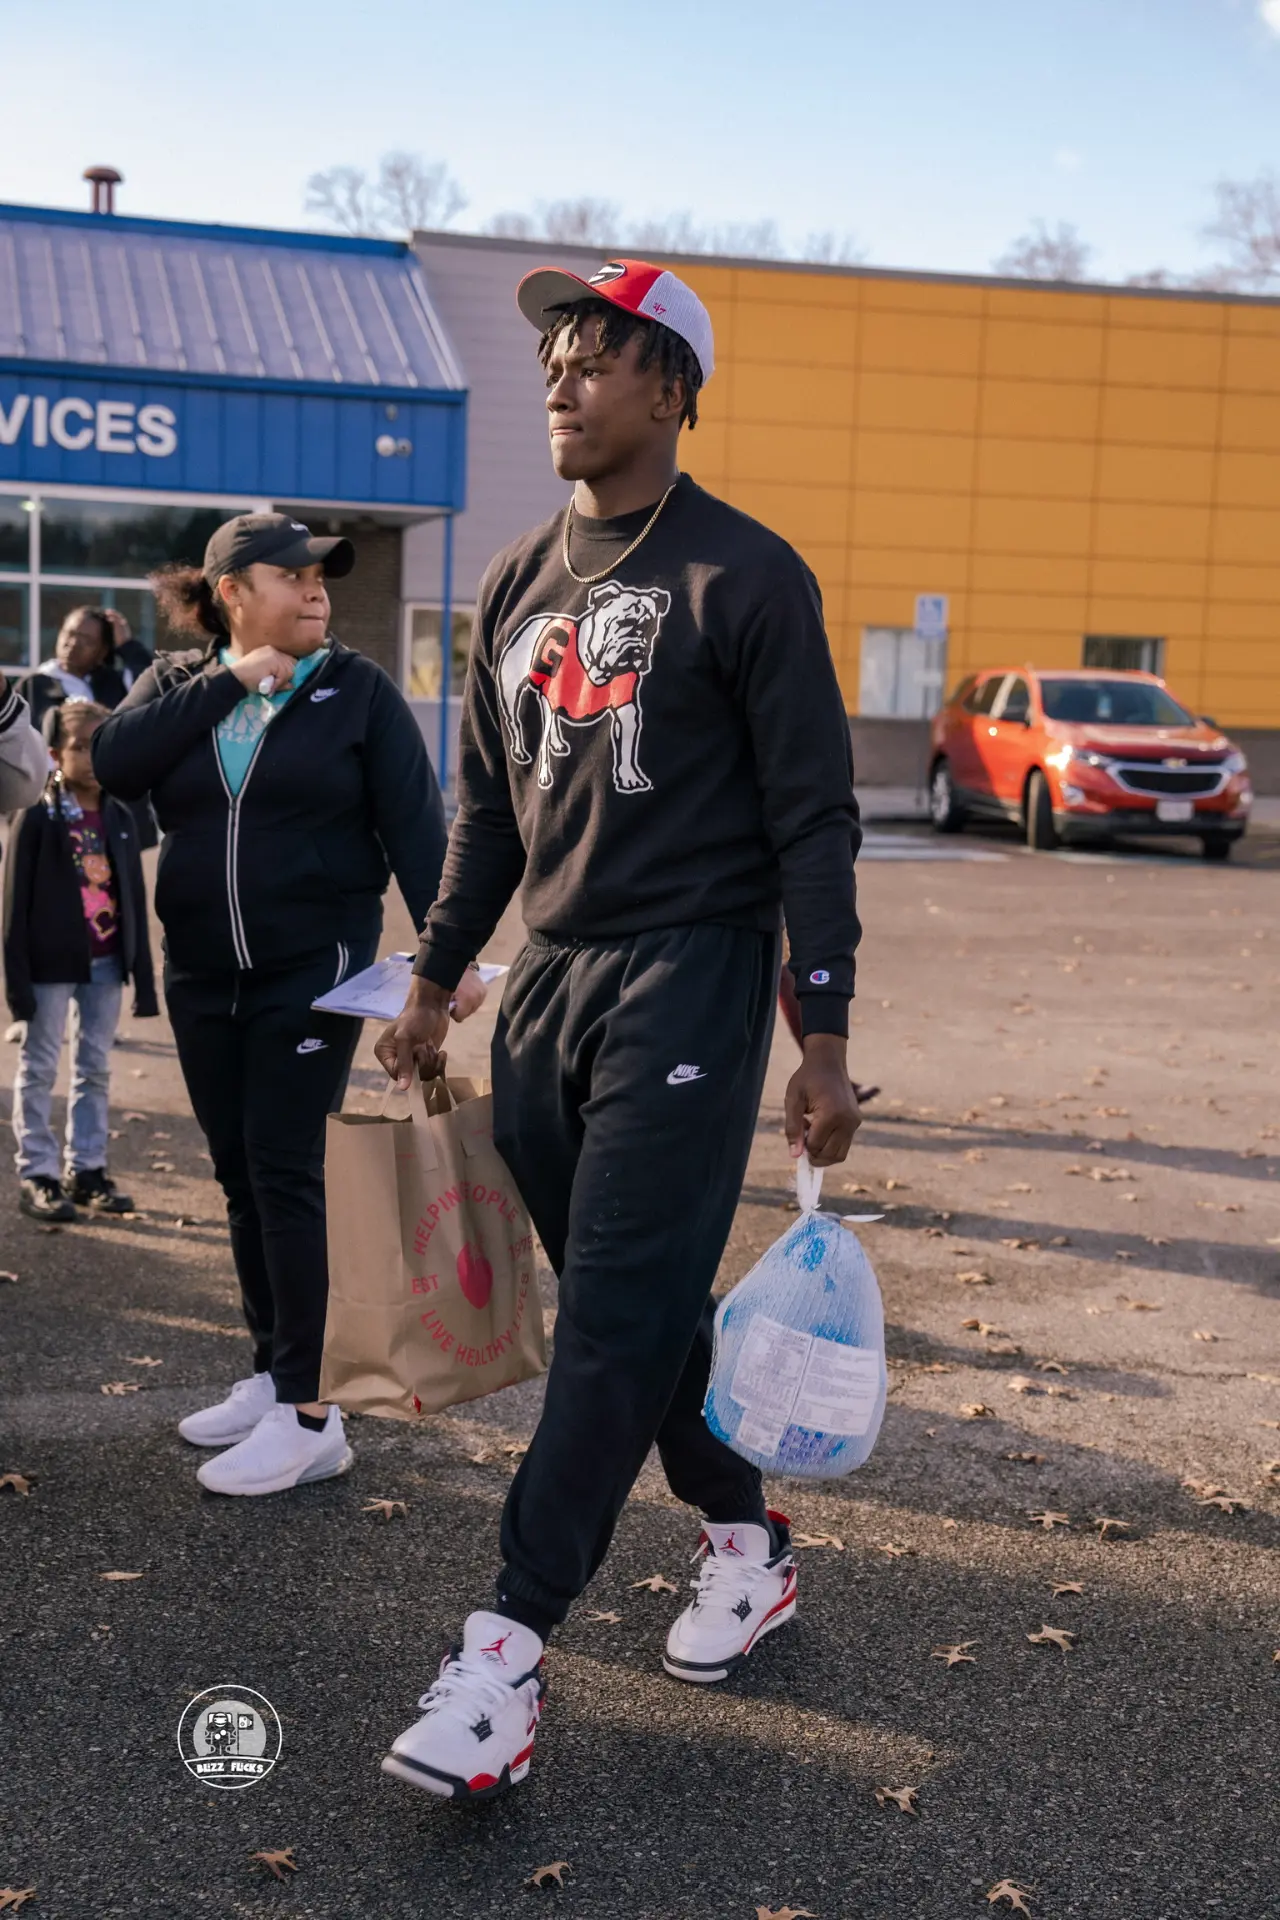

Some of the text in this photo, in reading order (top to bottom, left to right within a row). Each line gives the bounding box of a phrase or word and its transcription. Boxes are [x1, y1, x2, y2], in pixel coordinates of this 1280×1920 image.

[0, 394, 178, 457] VICES
[531, 626, 570, 678] G
[673, 1064, 700, 1077] NIKE
[412, 1181, 519, 1256] HELPIN EOPLE
[411, 1274, 438, 1294] EST
[420, 1272, 530, 1366] LIVE HEALTHY LIVES
